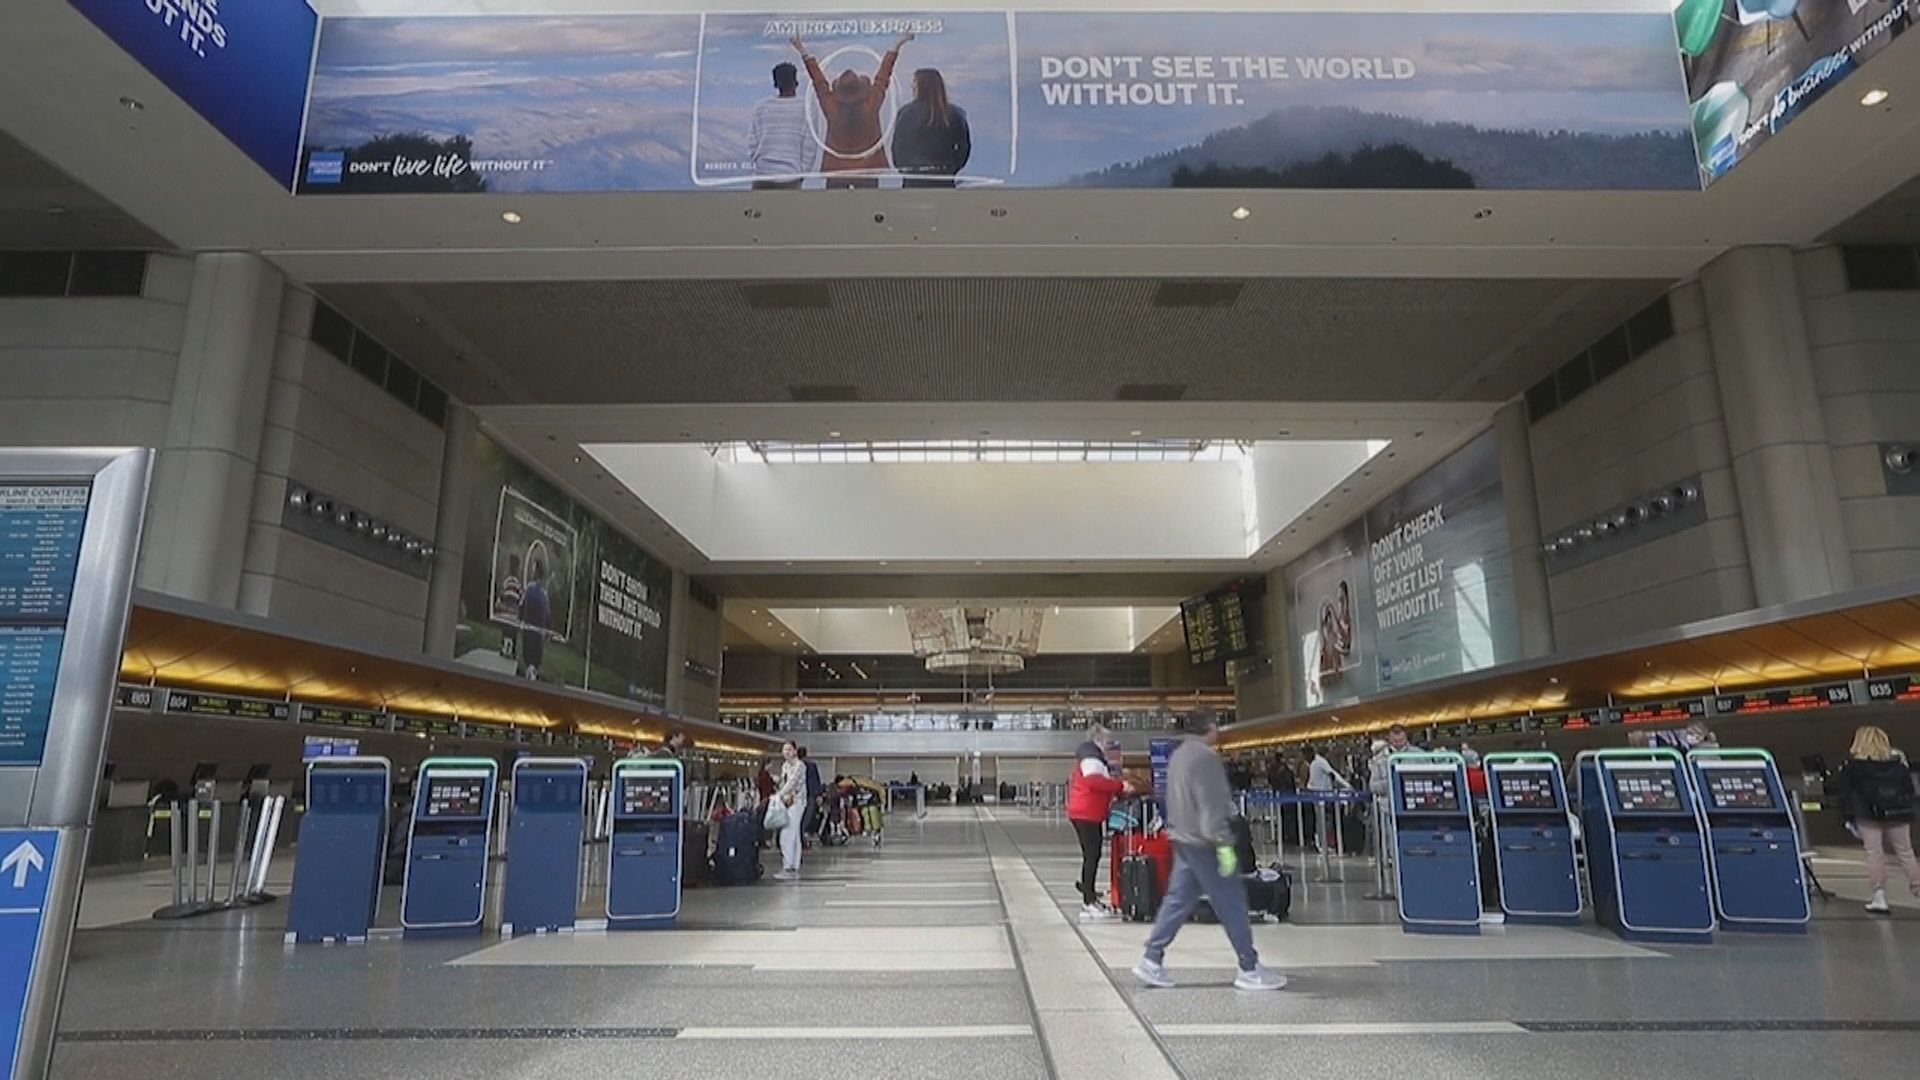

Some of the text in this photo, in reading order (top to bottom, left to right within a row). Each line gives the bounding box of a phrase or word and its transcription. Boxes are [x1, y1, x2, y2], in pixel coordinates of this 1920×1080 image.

[180, 20, 206, 58] IT.
[763, 18, 944, 36] AMERICAN EXPRESS
[1041, 57, 1416, 80] DON'T SEE THE WORLD
[1787, 45, 1850, 108] business
[1040, 83, 1245, 106] WITHOUT IT.
[350, 162, 391, 173] DON'T
[392, 154, 432, 178] live
[432, 153, 468, 179] life
[469, 160, 529, 172] WITHOUT
[1371, 504, 1445, 562] DON'T CHECK
[1374, 543, 1424, 584] OFF YOUR
[1376, 558, 1445, 608] BUCKET LIST
[1377, 587, 1444, 630] WITHOUT IT.
[1827, 686, 1849, 701] B36
[1869, 684, 1893, 698] B35
